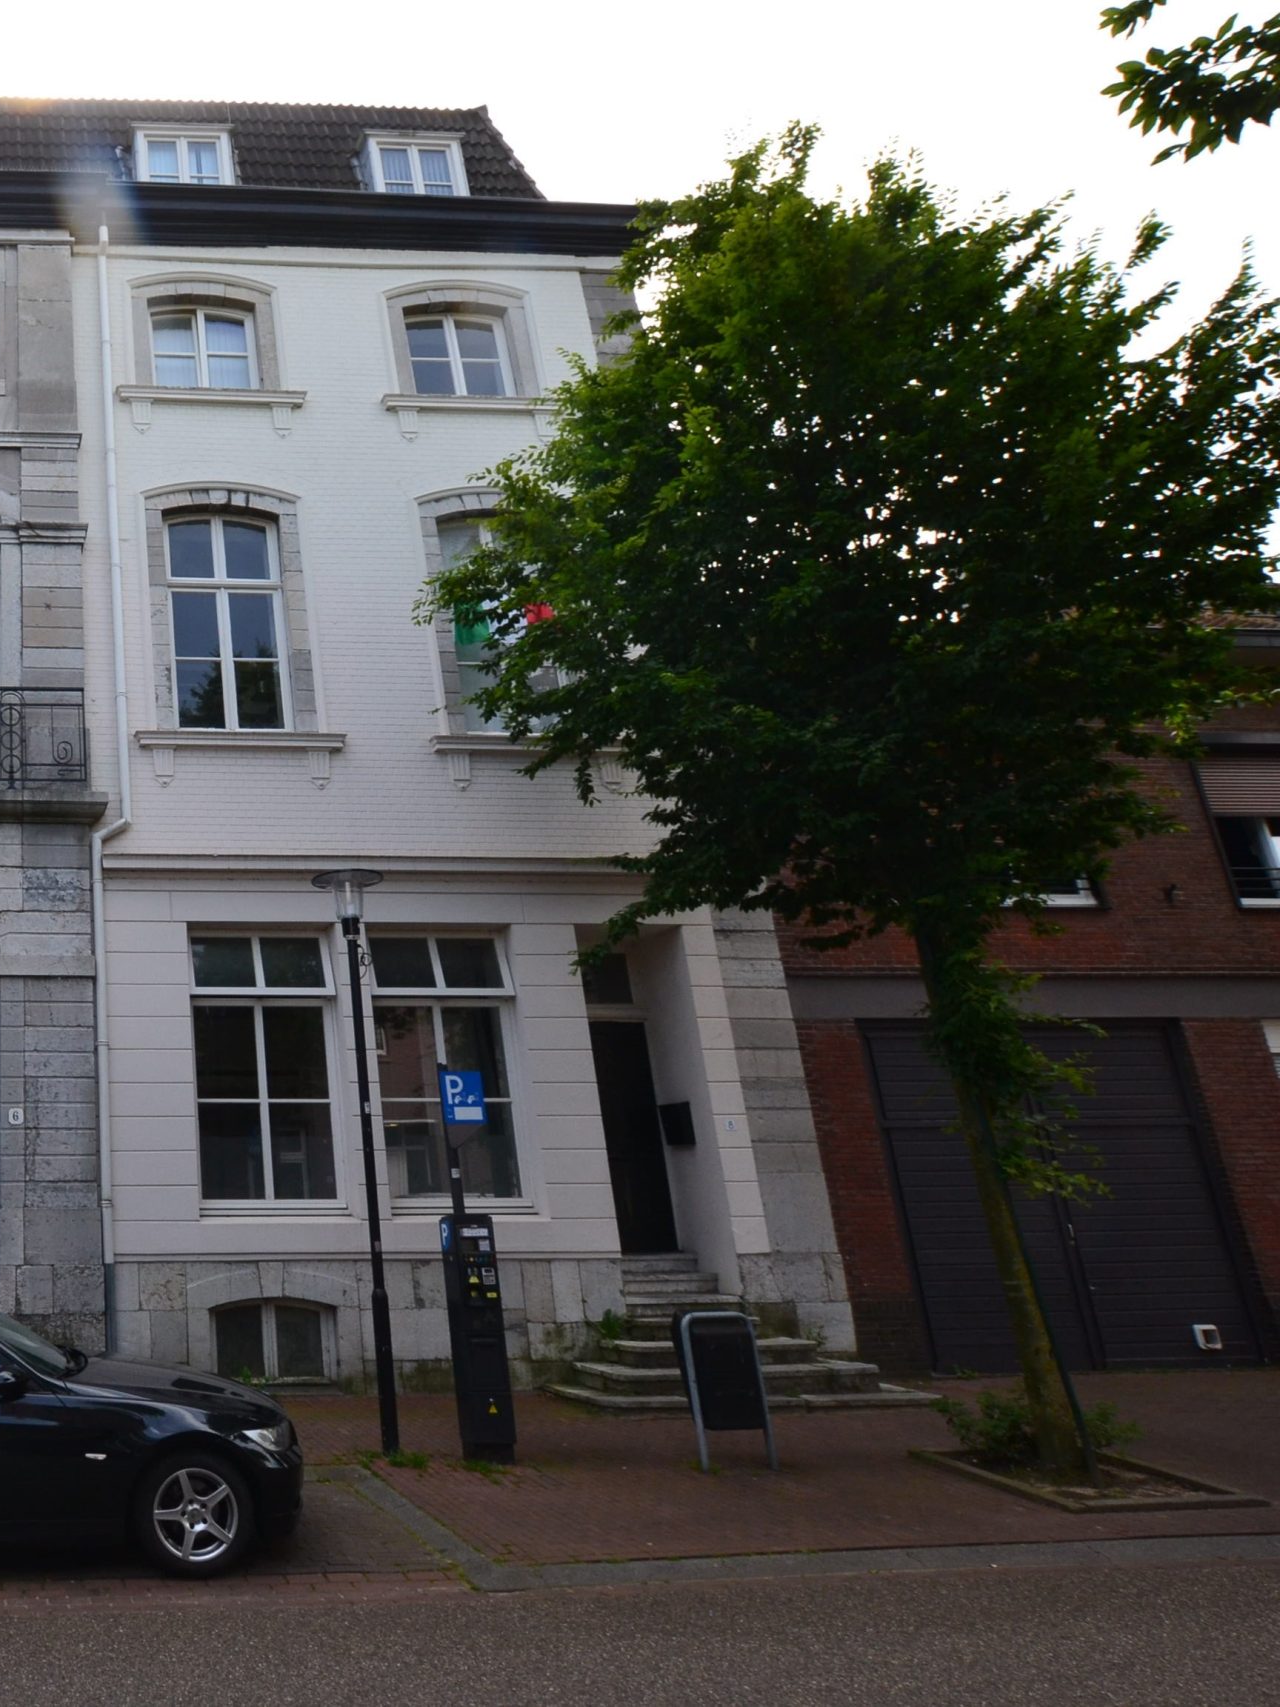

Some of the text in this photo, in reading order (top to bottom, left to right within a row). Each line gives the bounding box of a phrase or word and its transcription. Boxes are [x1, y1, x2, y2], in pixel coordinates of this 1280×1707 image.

[445, 1075, 463, 1104] P
[12, 1110, 19, 1122] 6
[728, 1120, 734, 1129] 8
[441, 1223, 448, 1246] P
